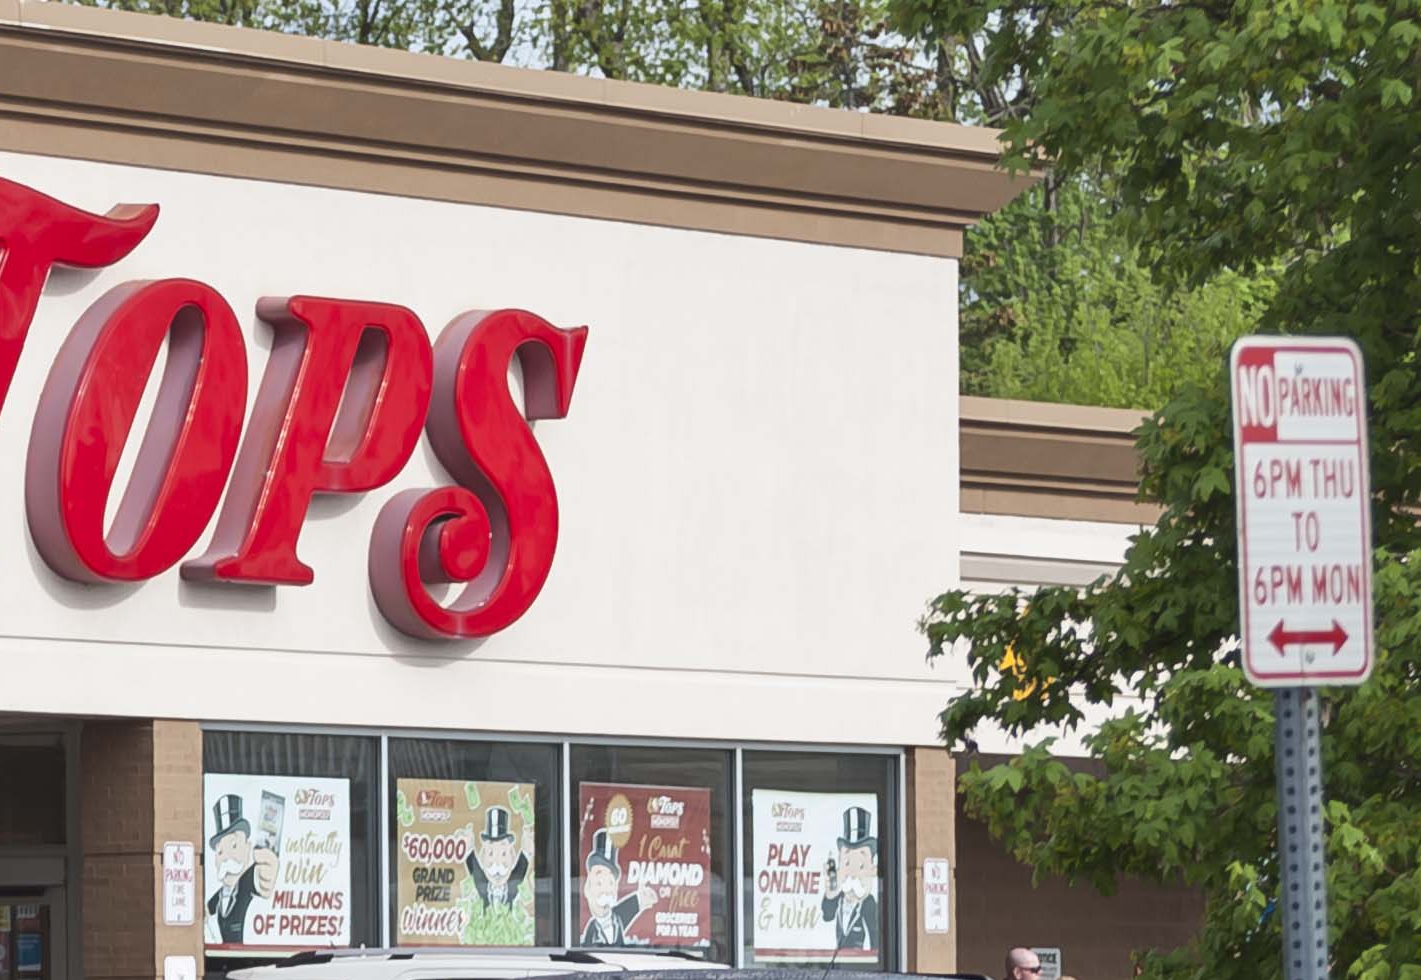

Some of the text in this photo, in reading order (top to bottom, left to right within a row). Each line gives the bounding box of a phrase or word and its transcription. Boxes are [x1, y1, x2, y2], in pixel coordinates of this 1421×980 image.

[1239, 364, 1354, 429] NO PARKING
[1253, 458, 1354, 499] 6PM THU
[1291, 510, 1320, 552] TO
[1253, 564, 1360, 606] 6PM MON
[403, 836, 467, 864] $60,000
[767, 843, 811, 868] PLAY
[412, 867, 455, 884] GRAND
[627, 861, 704, 887] DIAMOND
[758, 870, 821, 895] ONLINE
[271, 889, 344, 911] MILLIONS
[416, 886, 452, 903] PRIZE
[252, 914, 344, 936] OF PRIZES!
